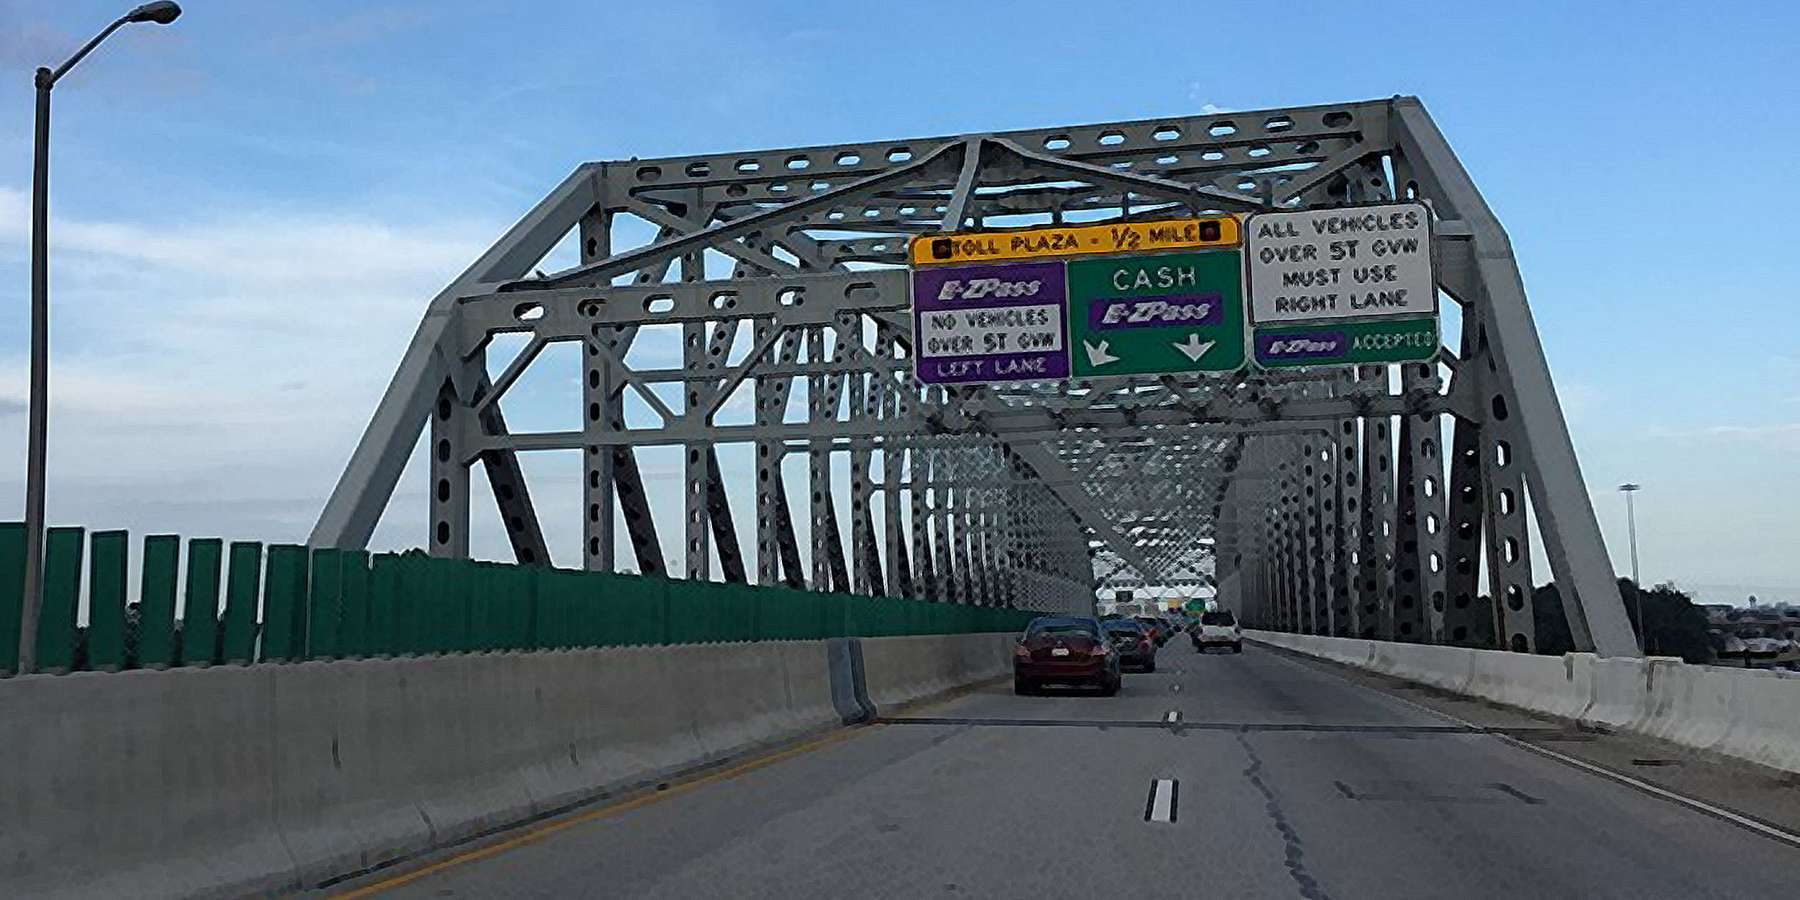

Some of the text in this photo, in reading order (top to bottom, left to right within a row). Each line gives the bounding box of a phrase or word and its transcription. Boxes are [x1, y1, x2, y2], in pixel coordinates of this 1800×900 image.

[1258, 211, 1419, 238] ALL VEHICLES
[952, 238, 999, 255] TOLL
[1010, 232, 1079, 252] PLAZA
[1150, 221, 1199, 242] MILE
[1259, 244, 1317, 264] OVER
[1371, 238, 1418, 257] GVW
[1113, 266, 1196, 291] CASH
[1282, 264, 1398, 288] MUST USE
[938, 277, 1042, 301] E-ZPass
[1275, 289, 1408, 313] RIGHT LANE
[931, 308, 1048, 330] NO VEHICLES
[1102, 300, 1212, 324] E-ZPass
[927, 334, 973, 354] OVER
[937, 356, 1047, 377] LEFT LANE
